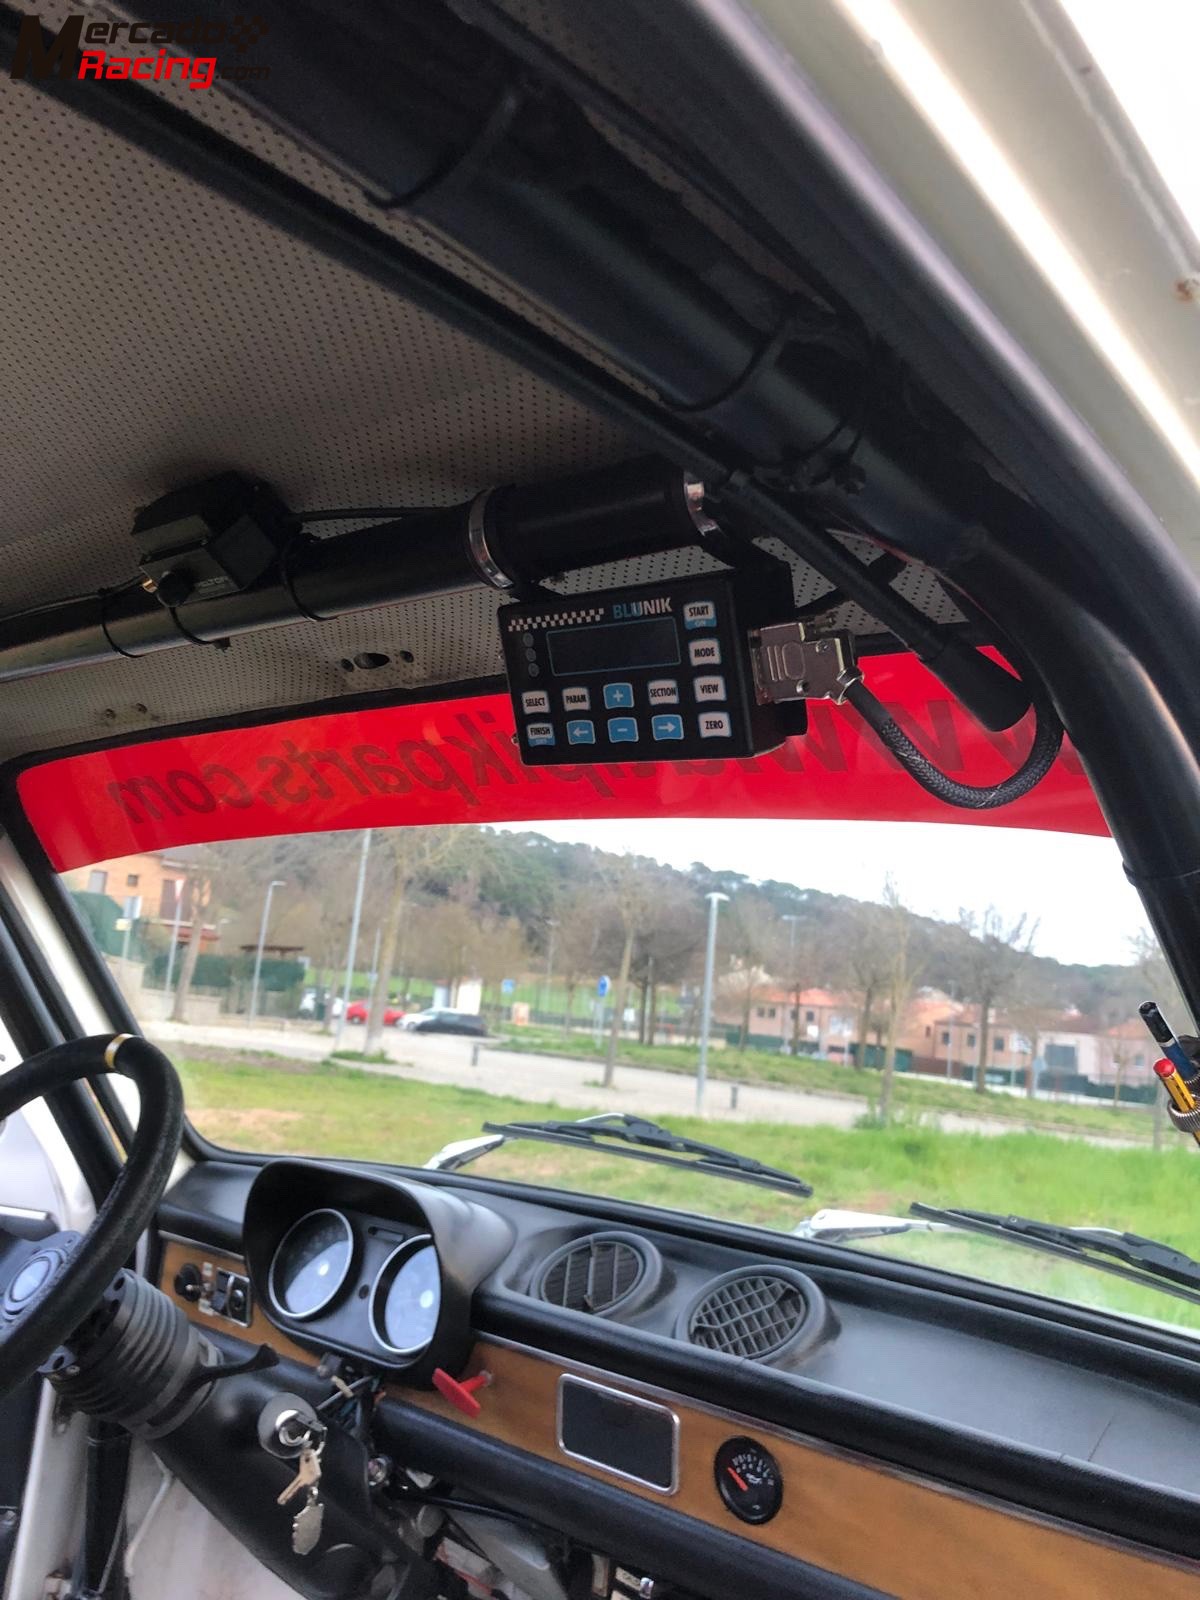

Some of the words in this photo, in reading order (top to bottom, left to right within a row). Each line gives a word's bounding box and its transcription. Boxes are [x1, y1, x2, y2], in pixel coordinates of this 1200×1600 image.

[613, 597, 672, 618] BLUNIK
[688, 605, 709, 617] START
[694, 647, 716, 658] MODE
[649, 687, 677, 698] SECTION
[700, 684, 719, 694] VIEW
[525, 697, 546, 707] SELECT
[565, 694, 587, 704] PARAM
[704, 719, 724, 730] ZERO
[530, 726, 551, 736] FINISH
